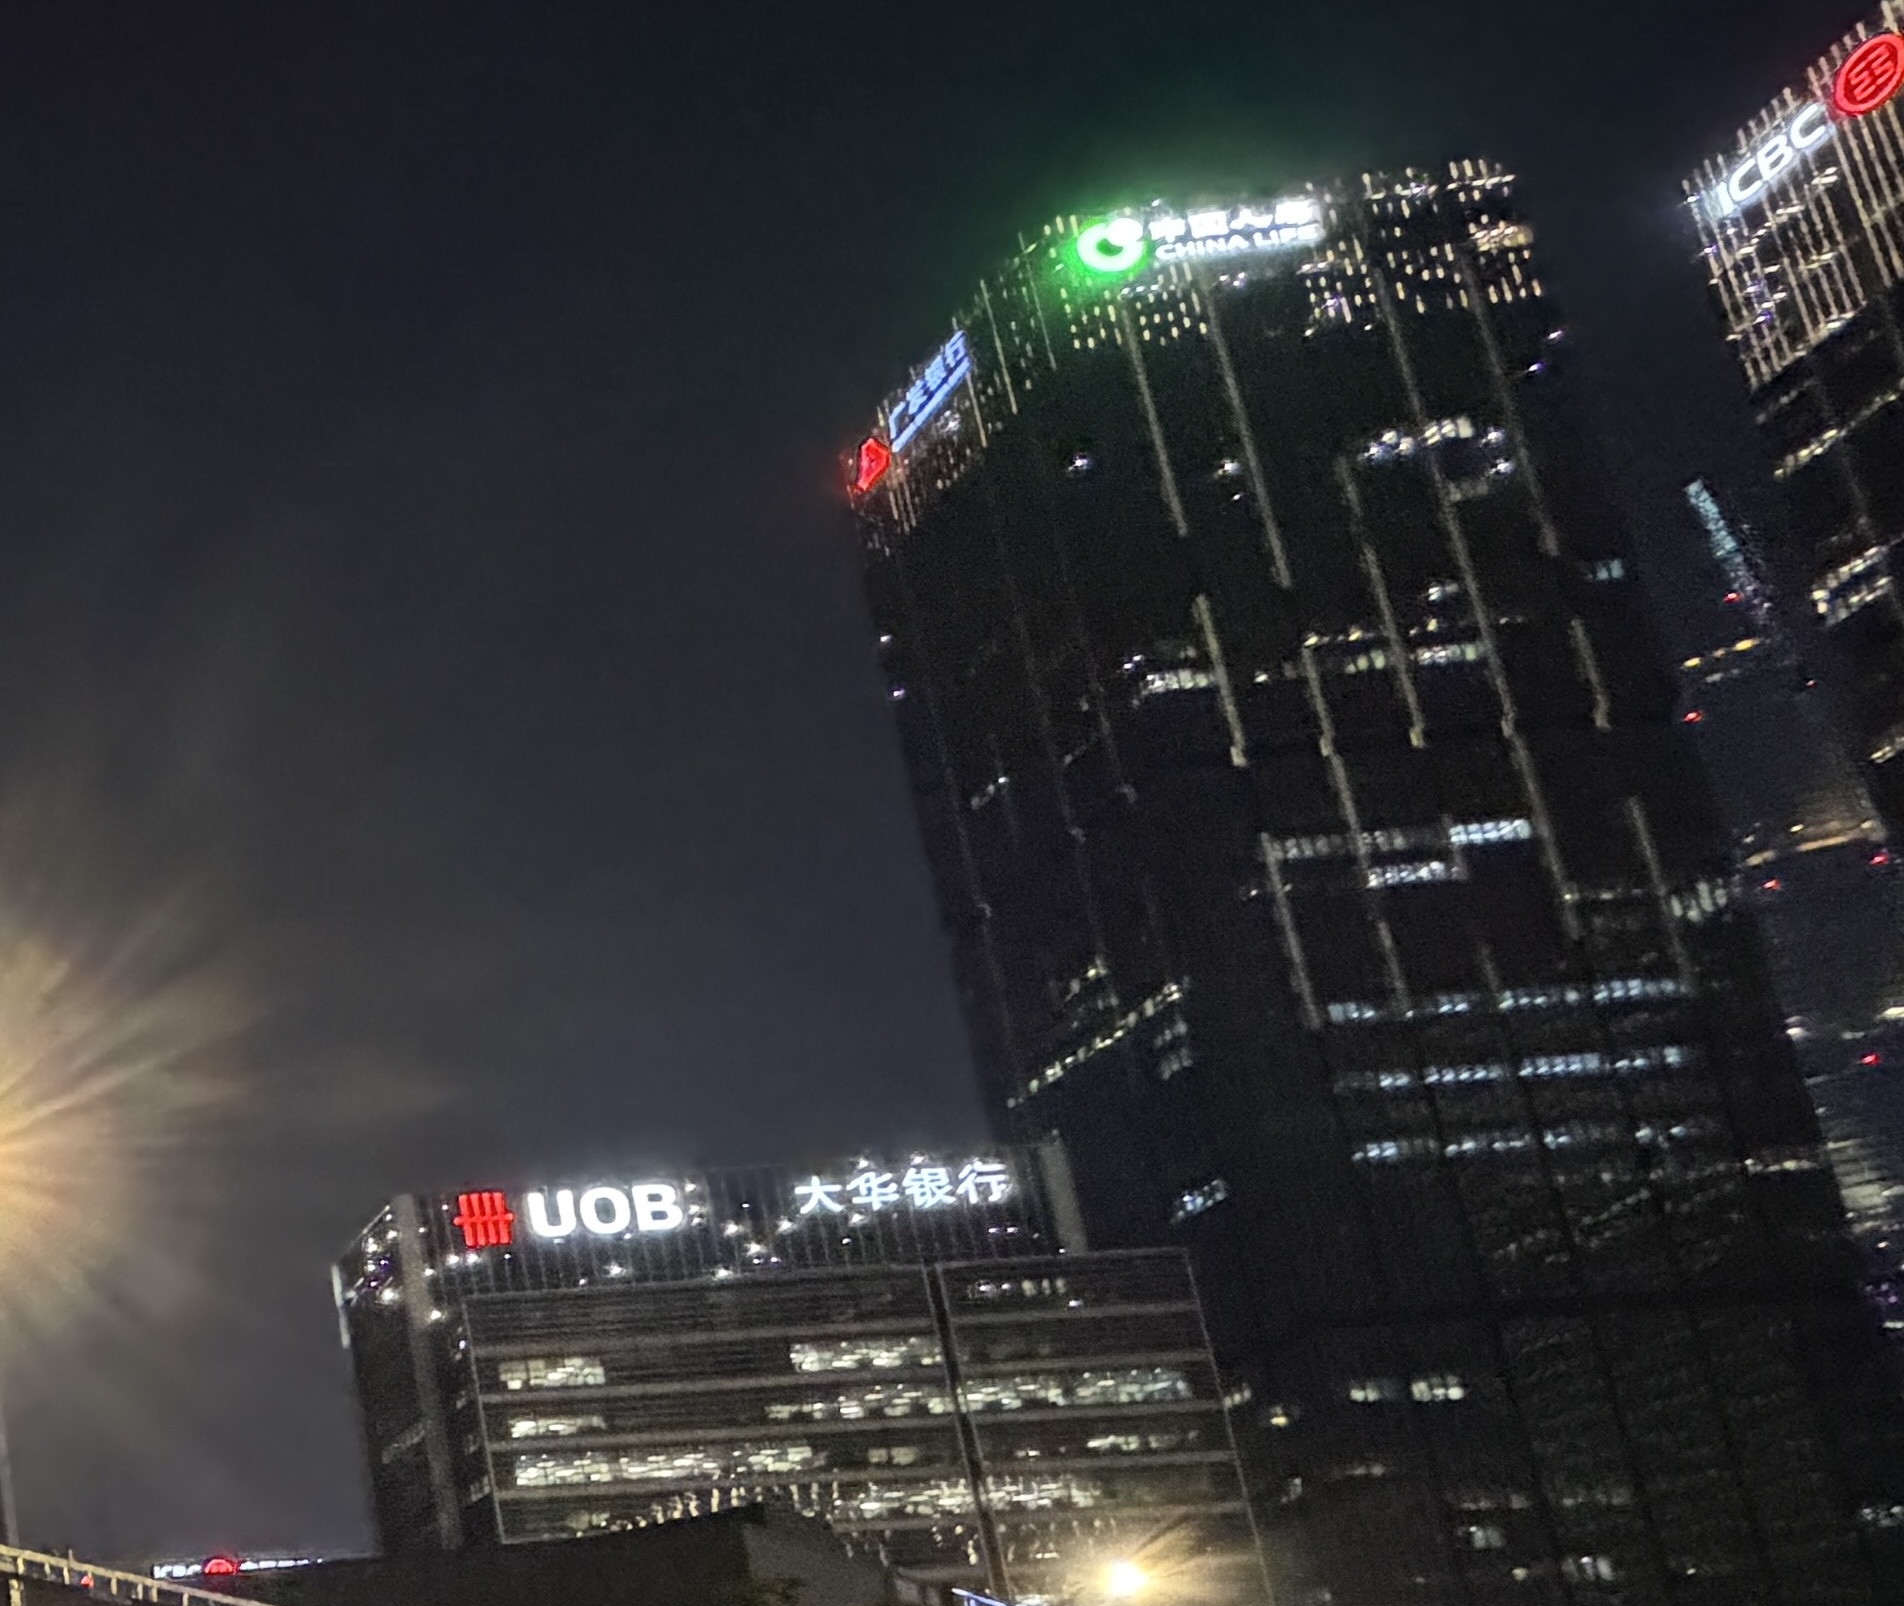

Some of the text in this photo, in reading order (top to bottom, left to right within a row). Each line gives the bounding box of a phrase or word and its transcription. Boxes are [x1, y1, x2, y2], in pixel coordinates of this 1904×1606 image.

[1714, 102, 1829, 218] ICBC
[1155, 235, 1250, 260] CHINA
[527, 1184, 683, 1237] UOB
[794, 1161, 1007, 1214] 大华银行
